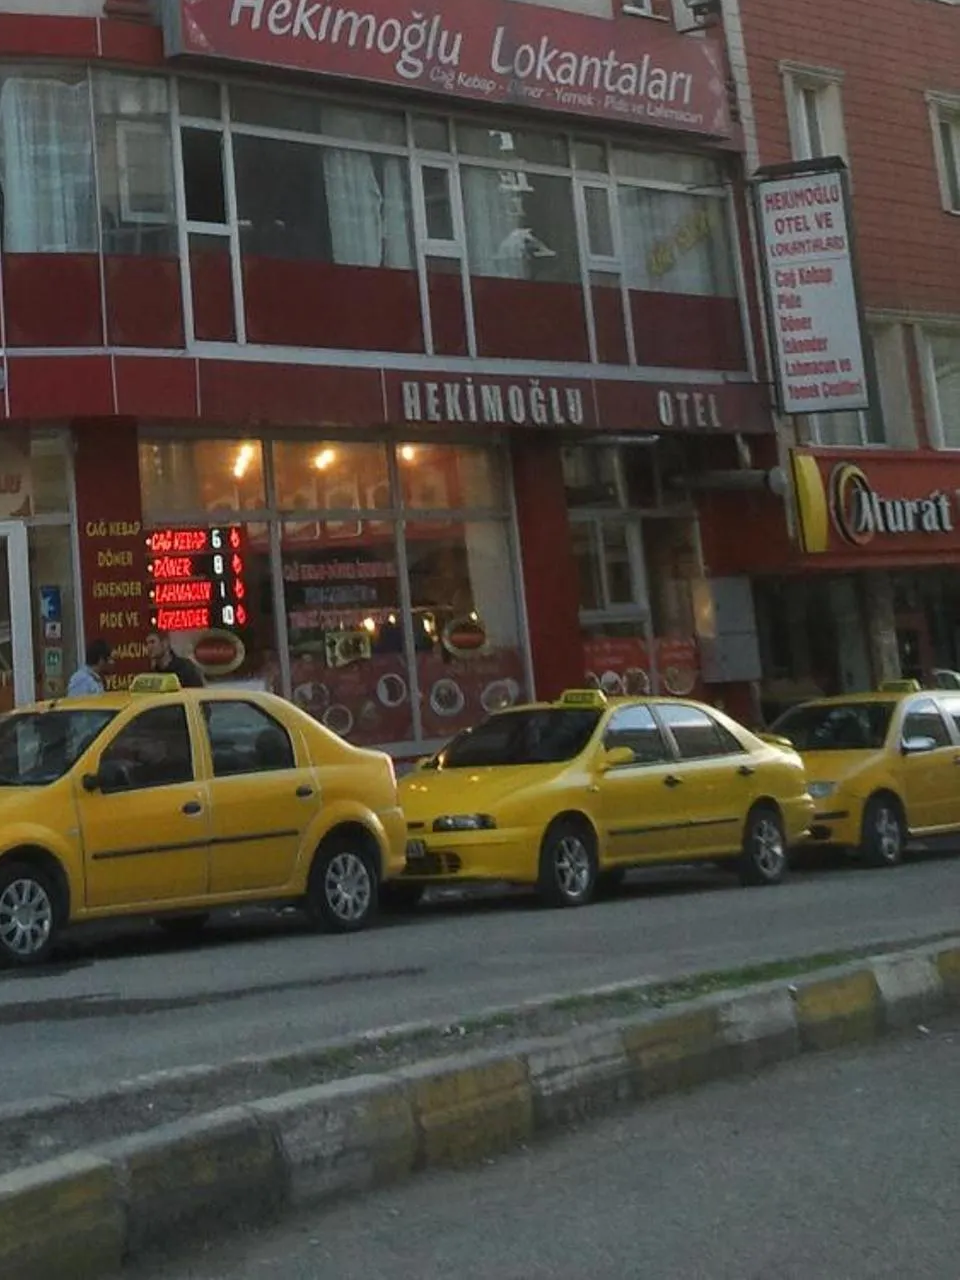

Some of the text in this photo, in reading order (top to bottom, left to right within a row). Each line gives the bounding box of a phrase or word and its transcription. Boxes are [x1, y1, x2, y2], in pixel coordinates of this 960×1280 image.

[491, 26, 693, 105] Lokantaları
[775, 211, 834, 235] OTEL VE
[401, 377, 722, 428] HEKİMOĞLU OTEL
[104, 673, 134, 690] YEME
